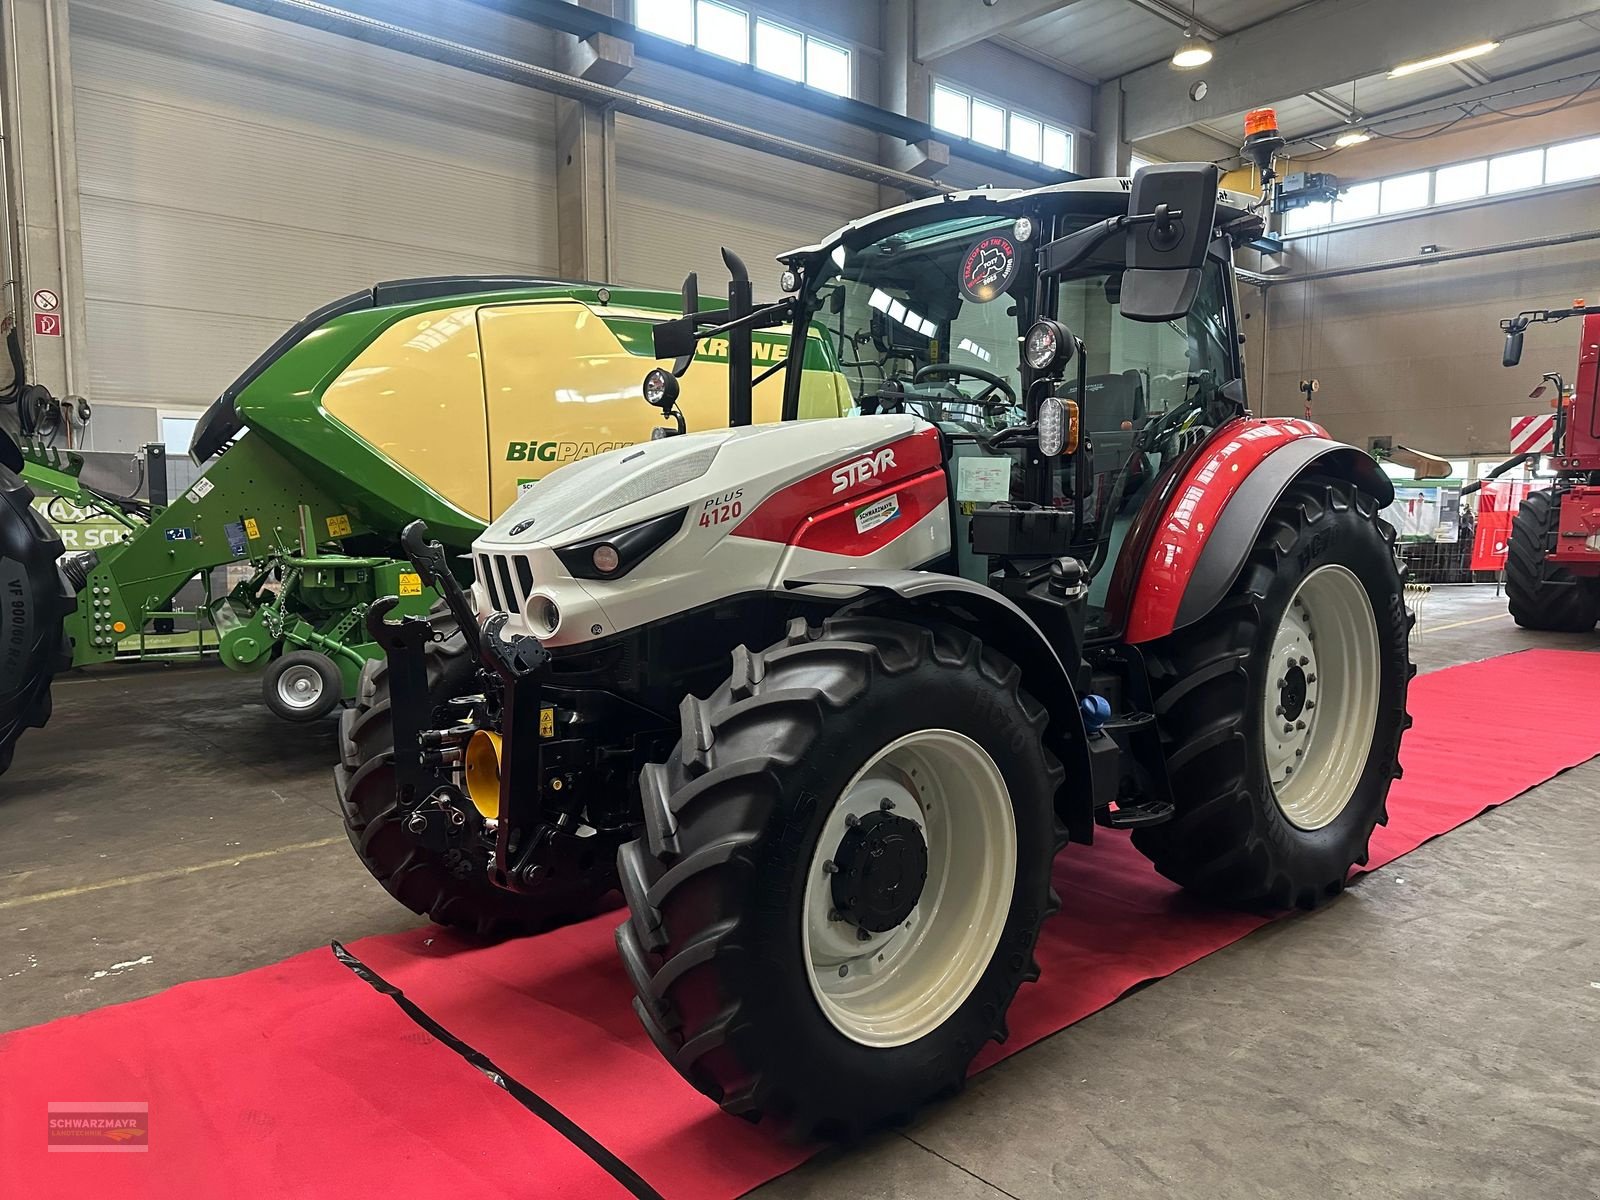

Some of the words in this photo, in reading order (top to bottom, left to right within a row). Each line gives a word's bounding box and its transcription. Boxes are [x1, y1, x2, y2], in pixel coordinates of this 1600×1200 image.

[983, 256, 998, 269] TOTY
[696, 337, 788, 361] KRNE
[831, 448, 898, 495] STEYR
[703, 487, 744, 510] PLUS
[698, 500, 742, 528] 4120
[859, 501, 893, 520] SCHWARZMAYR
